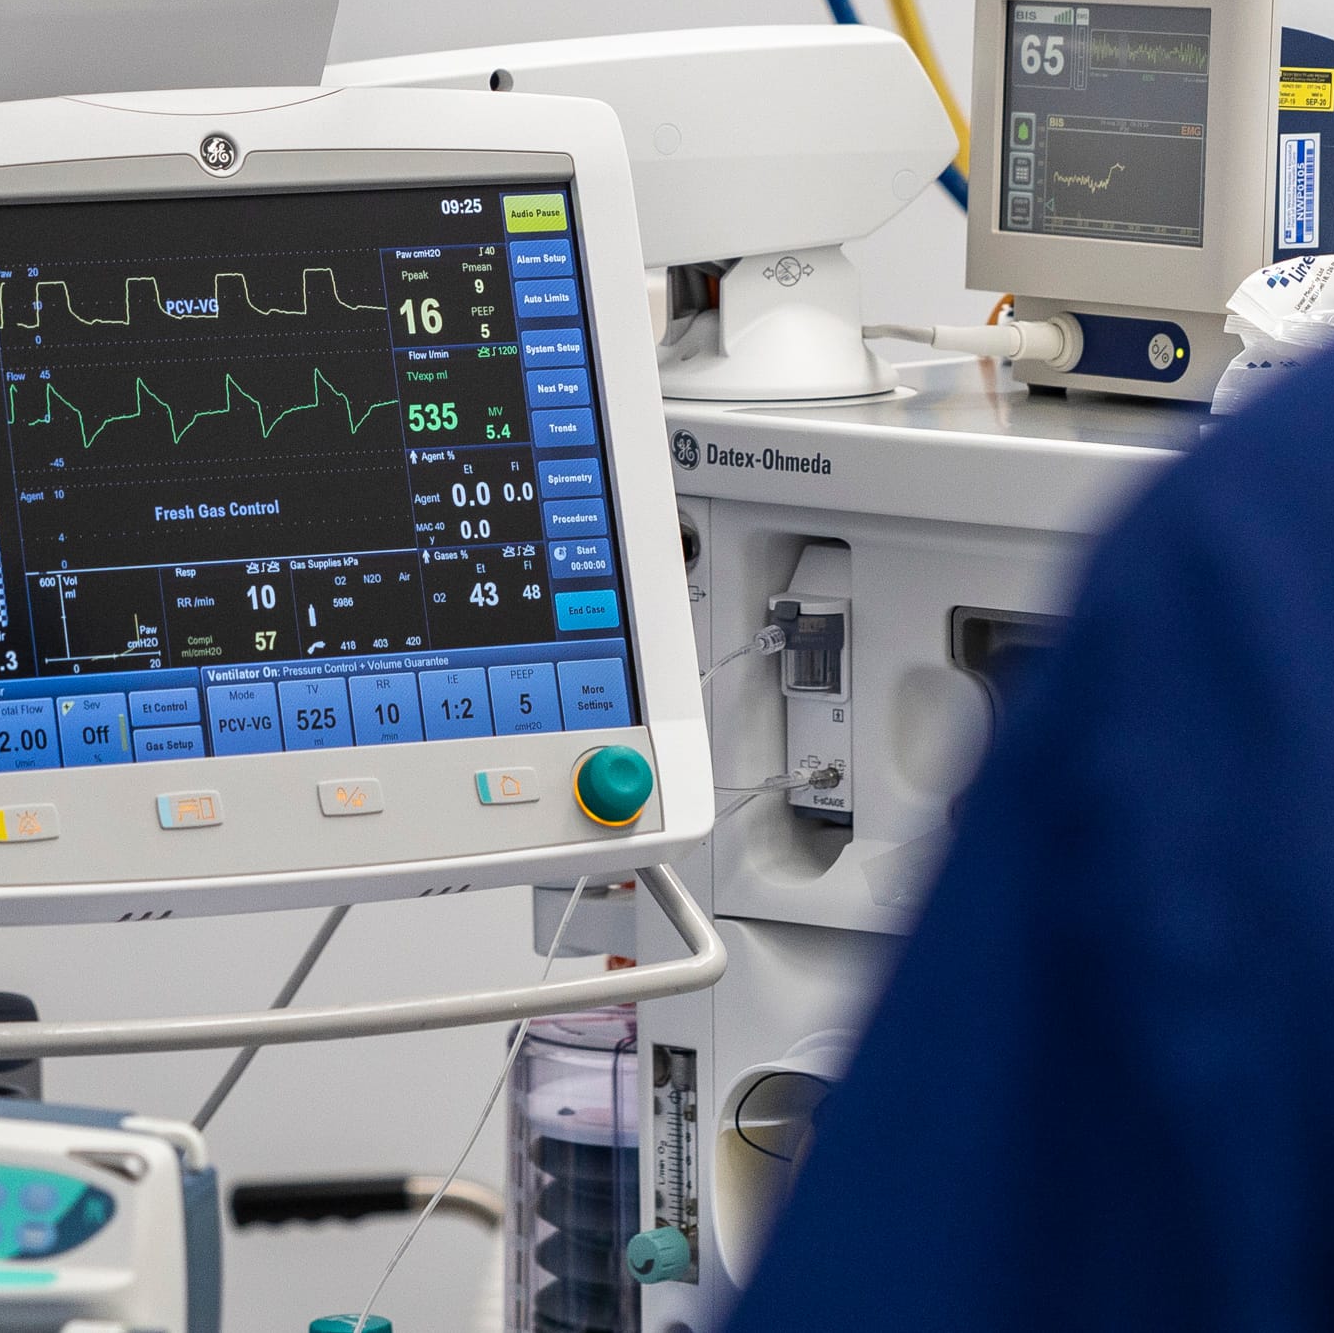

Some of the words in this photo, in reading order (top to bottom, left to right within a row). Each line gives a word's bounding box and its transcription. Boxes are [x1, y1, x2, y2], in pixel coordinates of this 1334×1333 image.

[1016, 11, 1037, 20] BIS
[1021, 35, 1064, 75] 65
[1049, 117, 1064, 127] BIS
[1181, 126, 1201, 135] EMG
[1297, 162, 1305, 221] NWP0105
[441, 199, 482, 214] 09:25
[511, 210, 533, 218] Audio
[536, 209, 560, 217] Pause
[396, 250, 411, 258] Paw
[517, 255, 541, 263] Alarm
[543, 254, 566, 263] Setup
[28, 268, 38, 277] 20
[462, 263, 492, 272] Pmean
[402, 271, 429, 280] Ppeak
[475, 279, 484, 293] 9
[524, 295, 542, 303] Auto
[544, 294, 569, 302] Limits
[166, 299, 219, 314] PCV-VG
[471, 307, 494, 316] PEEP
[400, 298, 443, 334] 16
[481, 324, 490, 338] 5
[526, 345, 555, 354] System
[557, 344, 580, 353] Setup
[409, 351, 427, 360] Flow
[7, 372, 25, 381] Flow
[40, 371, 50, 379] 45
[538, 385, 556, 393] Next
[558, 384, 578, 394] Page
[488, 407, 503, 415] MV
[409, 402, 458, 432] 535
[486, 424, 511, 440] 5.4
[549, 424, 577, 432] Trends
[422, 453, 445, 461] Agent
[706, 443, 831, 475] Datex-Ohmeda
[548, 474, 592, 484] Spirometry
[20, 491, 44, 502] Agent
[415, 494, 440, 505] Agent
[452, 482, 490, 507] 0.0
[503, 482, 533, 501] 0.0
[155, 505, 195, 521] Fresh
[198, 504, 224, 518] Gas
[229, 500, 280, 517] Control
[553, 515, 597, 524] Procedures
[460, 520, 490, 539] 0.0
[577, 546, 596, 554] Start
[434, 552, 458, 560] Gases
[308, 558, 341, 569] Supplies
[343, 557, 358, 567] kPa
[176, 568, 196, 578] Resp
[247, 585, 276, 610] 10
[469, 582, 499, 607] 43
[523, 585, 541, 600] 48
[177, 597, 193, 607] RR
[569, 607, 583, 615] End
[586, 606, 605, 614] Case
[255, 631, 277, 650] 57
[207, 670, 259, 682] Ventilator
[283, 666, 323, 677] Pressure
[325, 662, 357, 673] Control
[368, 660, 402, 670] Volume
[404, 656, 449, 668] Guarantee
[510, 669, 533, 679] PEEP
[582, 685, 604, 695] More
[229, 691, 254, 700] Mode
[157, 701, 187, 712] Control
[519, 694, 532, 714] 5
[578, 699, 614, 711] Settings
[20, 705, 43, 714] Flow
[375, 704, 400, 725] 10
[441, 699, 474, 720] 1:2
[297, 707, 337, 730] 525
[219, 716, 272, 733] PCV-VG
[83, 726, 109, 744] Off
[146, 741, 165, 750] Gas
[167, 740, 193, 750] Setup
